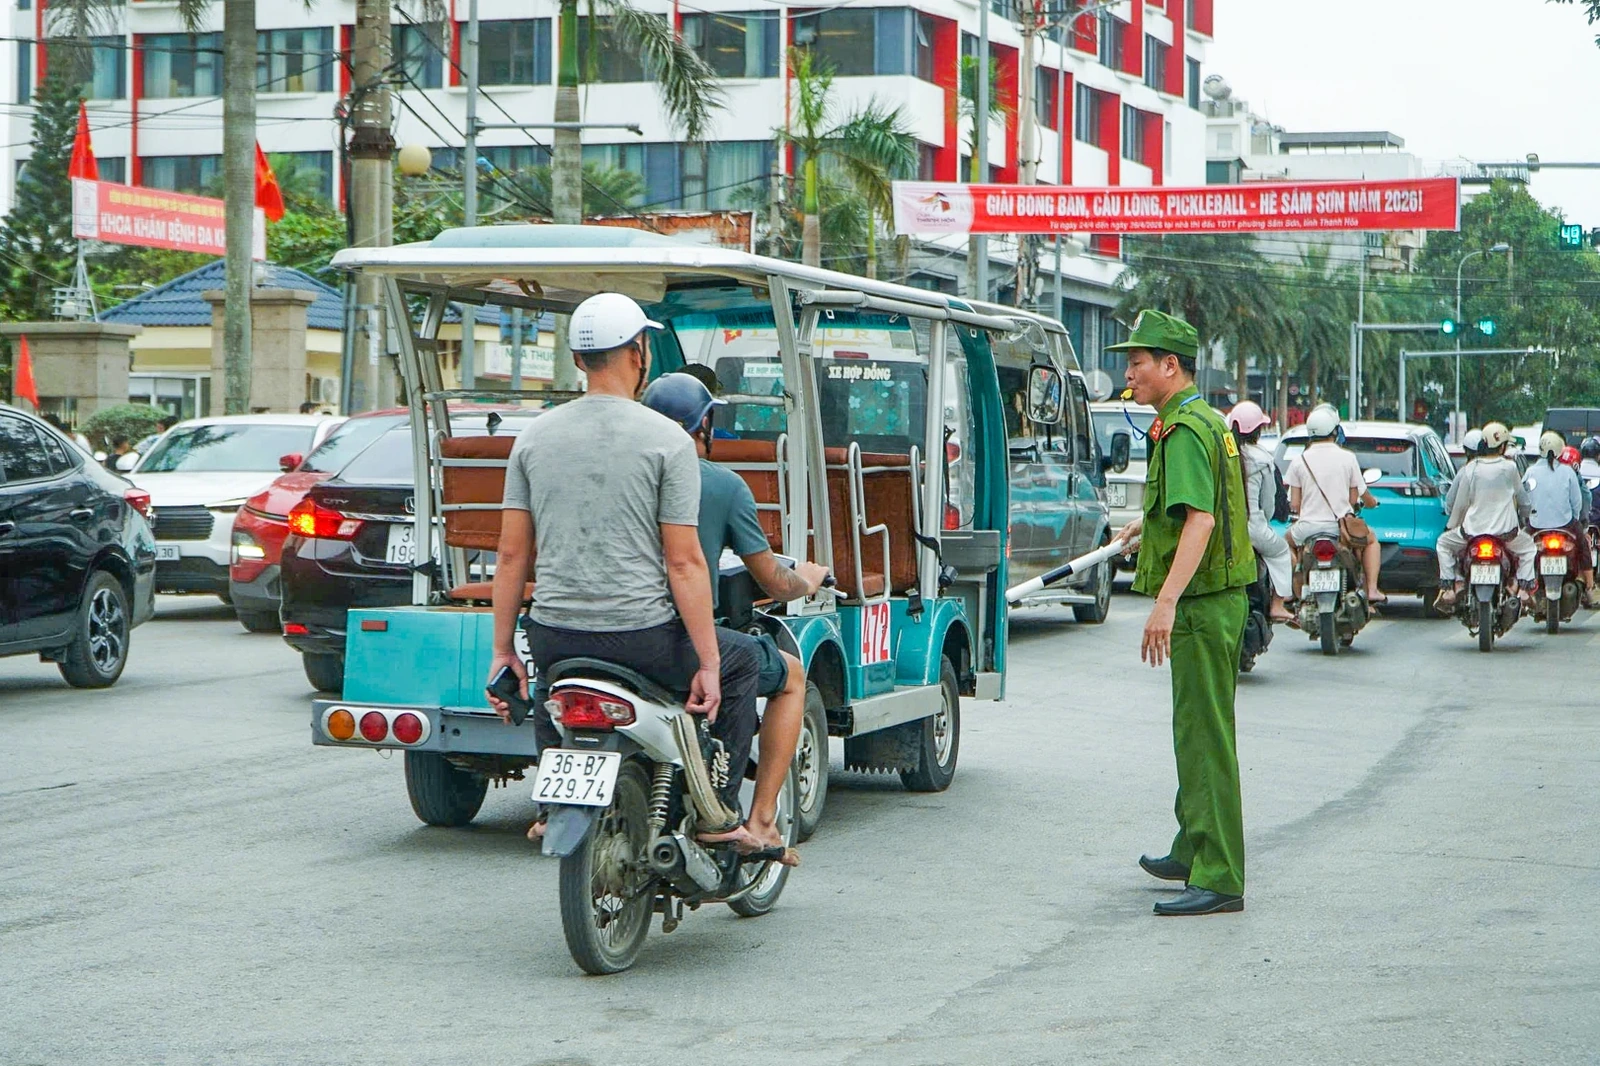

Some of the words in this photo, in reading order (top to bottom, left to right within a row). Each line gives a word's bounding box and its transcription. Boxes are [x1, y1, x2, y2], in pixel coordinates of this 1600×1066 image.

[986, 189, 1014, 216] GIẢI
[1167, 193, 1247, 216] PICKLEBALL
[1260, 191, 1278, 215] HÈ
[1316, 190, 1345, 214] SƠN
[1350, 187, 1381, 213] NĂM
[1385, 189, 1423, 212] 2026!
[101, 212, 132, 234] KHOA
[134, 213, 165, 240] KHÁM
[168, 218, 195, 247] BỆNH
[198, 227, 213, 246] ĐA
[1319, 217, 1342, 227] Thanh
[1562, 226, 1579, 244] 49
[1480, 321, 1492, 334] 49
[828, 367, 841, 379] XE
[843, 366, 862, 383] HỢP
[863, 362, 891, 380] ĐỒNG
[863, 603, 888, 663] 472
[551, 754, 607, 777] 36-B7
[539, 777, 605, 801] 229.74
